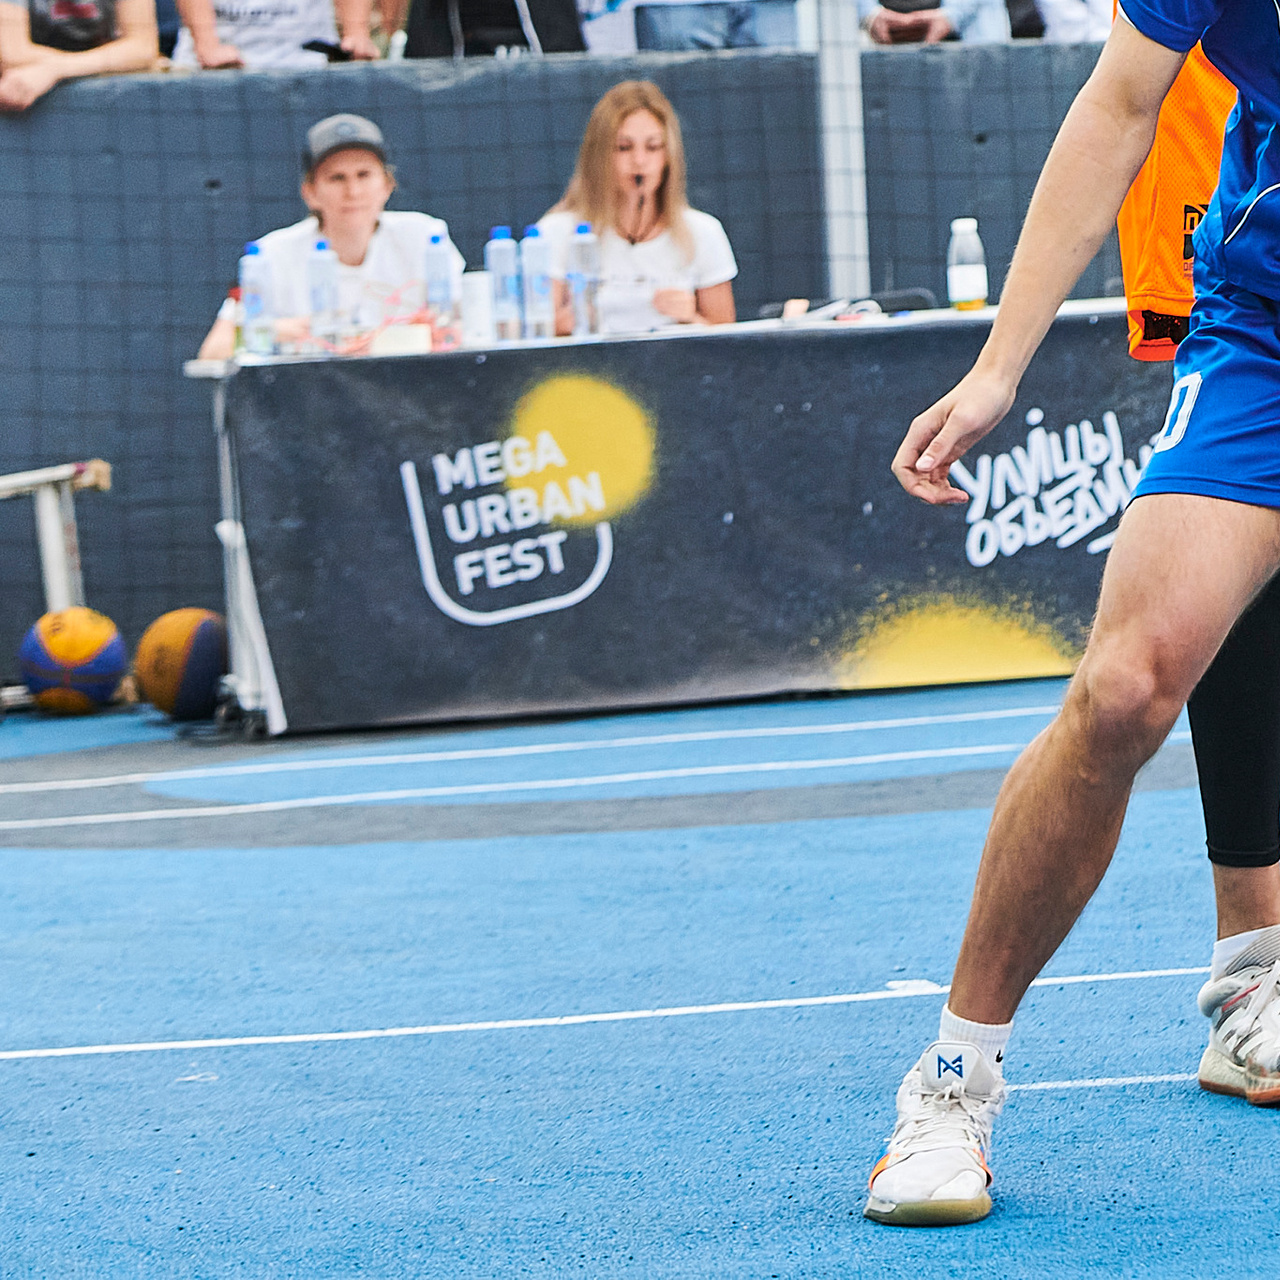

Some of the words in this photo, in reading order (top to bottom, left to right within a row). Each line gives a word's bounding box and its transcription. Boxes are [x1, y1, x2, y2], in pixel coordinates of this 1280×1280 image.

[432, 430, 567, 495] MEGA
[442, 471, 606, 544] URBAN
[965, 433, 1160, 567] ОБЪЕДИ
[454, 531, 568, 595] FEST
